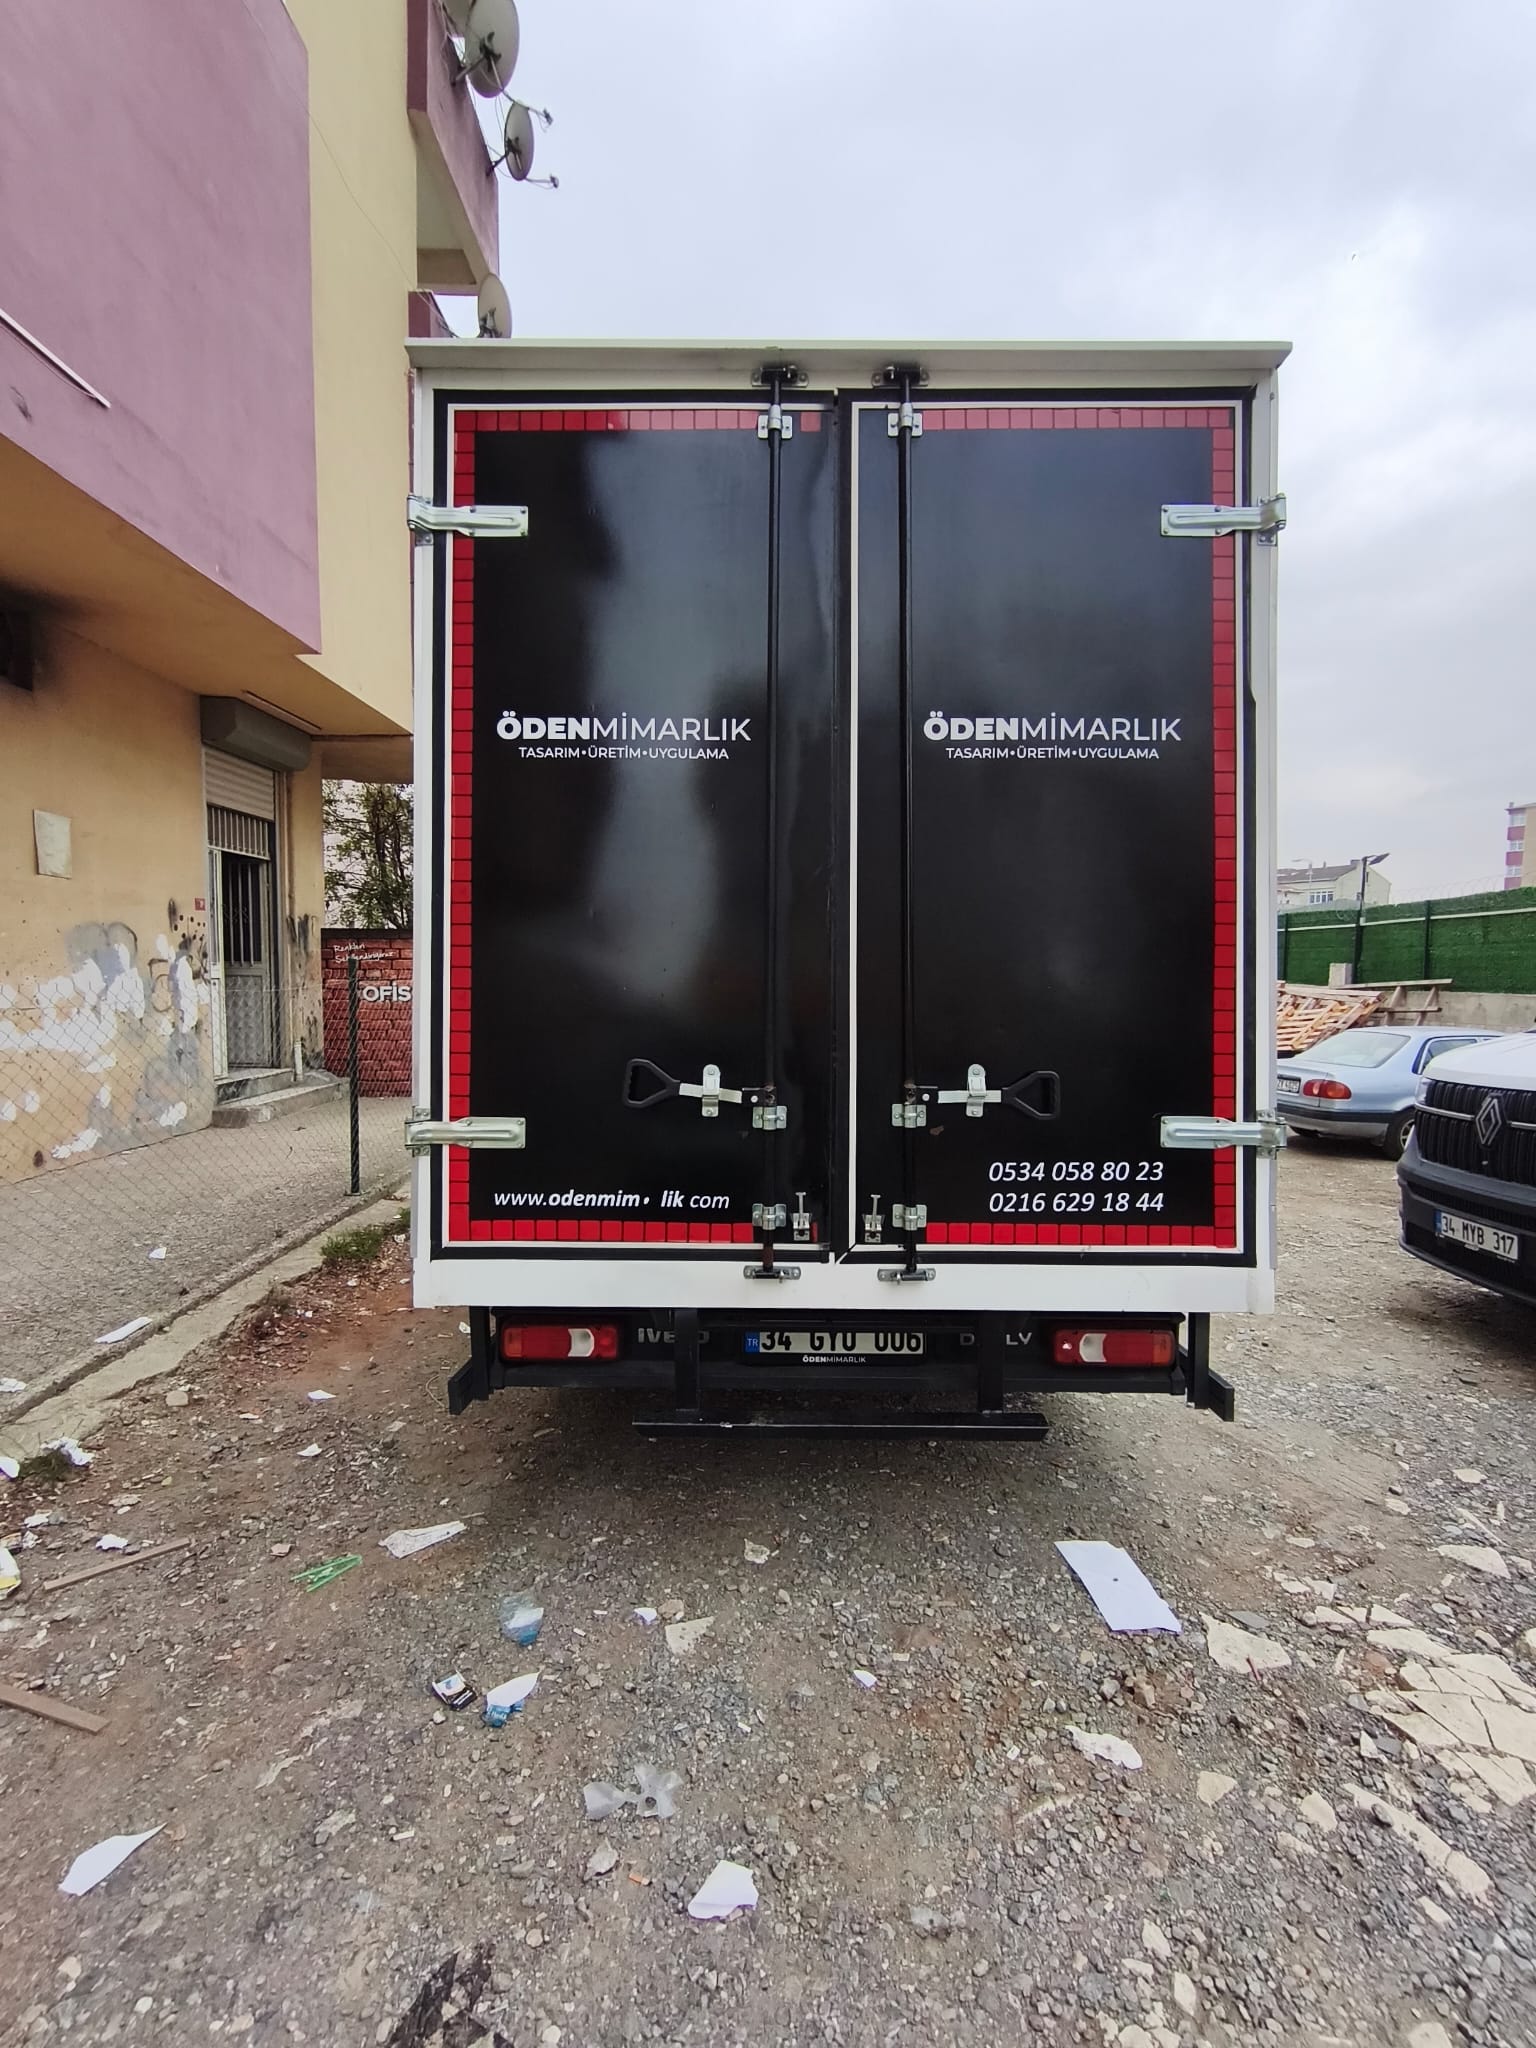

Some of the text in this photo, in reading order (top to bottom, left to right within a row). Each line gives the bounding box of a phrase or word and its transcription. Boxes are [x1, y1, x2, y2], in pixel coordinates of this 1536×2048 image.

[362, 981, 411, 1002] OFİS
[988, 1161, 1164, 1182] 0534 058 80 23
[989, 1192, 1164, 1213] 0216 629 18 44
[1442, 1215, 1515, 1255] 34 MYB 317
[762, 1332, 792, 1351] 34
